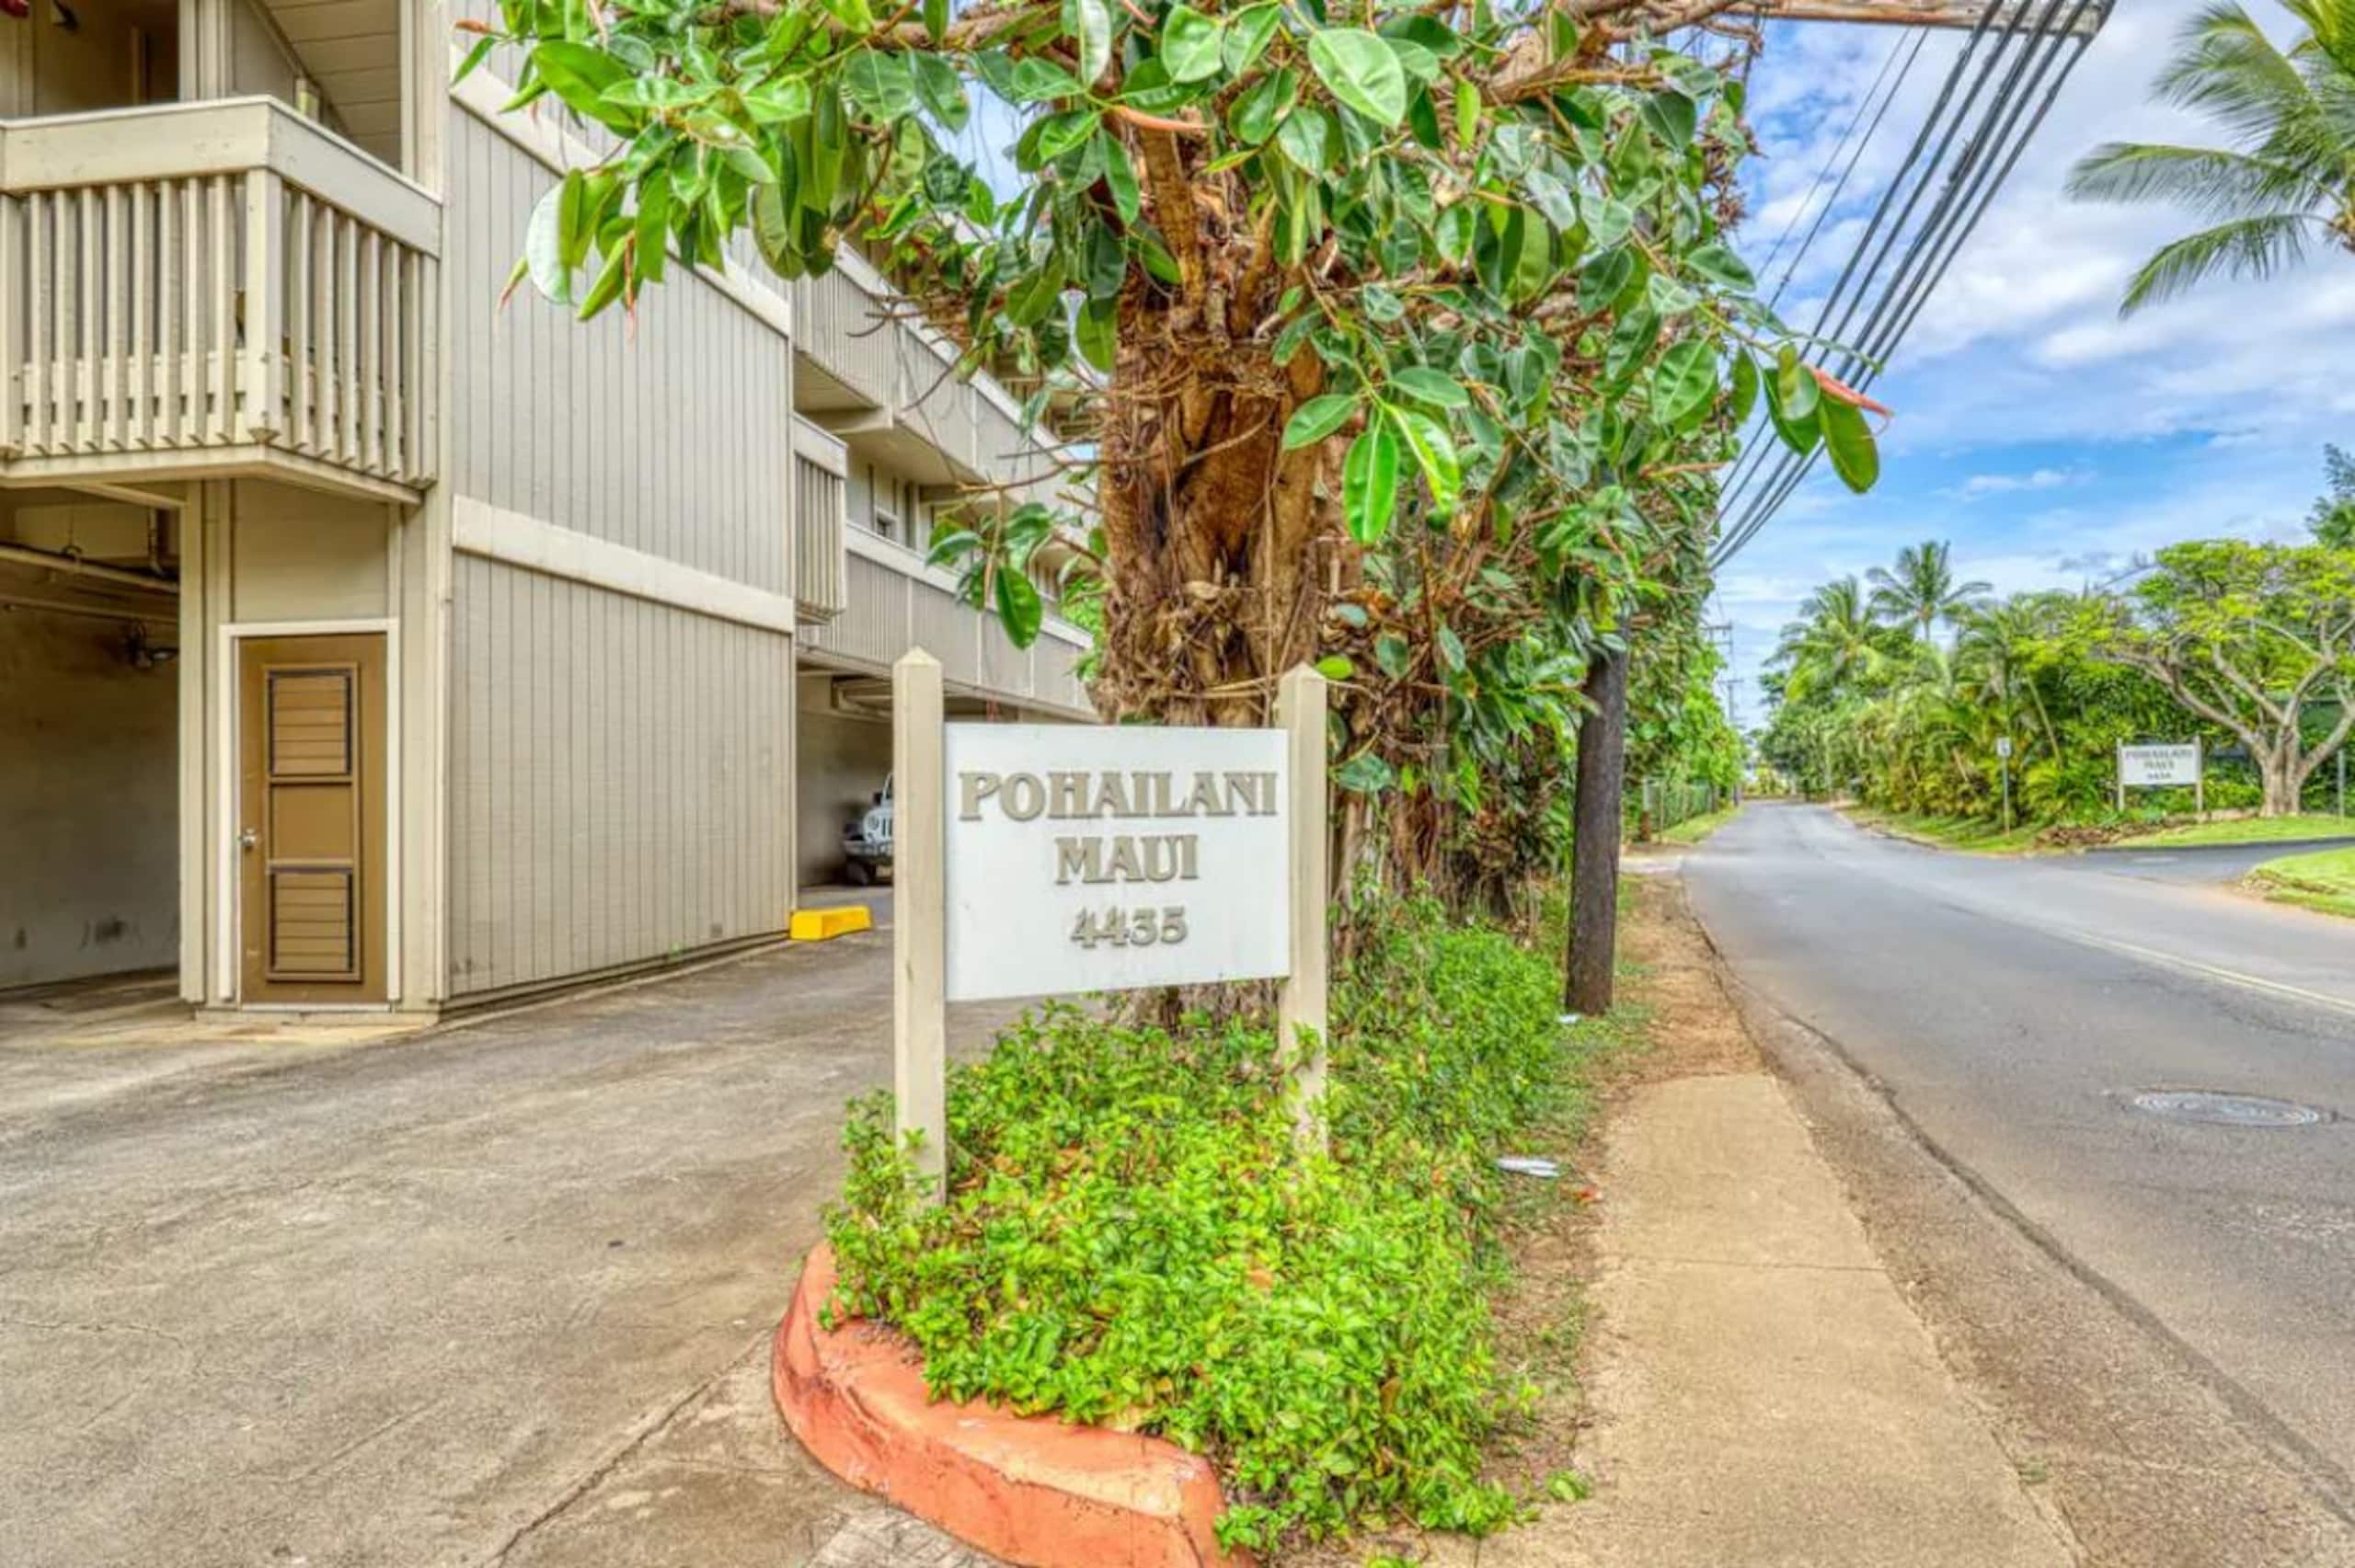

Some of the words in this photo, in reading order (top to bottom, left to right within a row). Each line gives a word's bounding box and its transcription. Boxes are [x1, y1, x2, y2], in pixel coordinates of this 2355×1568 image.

[958, 772, 1278, 821] POHAILANI
[1055, 835, 1200, 885] MAUI
[1070, 905, 1188, 948] 4435
